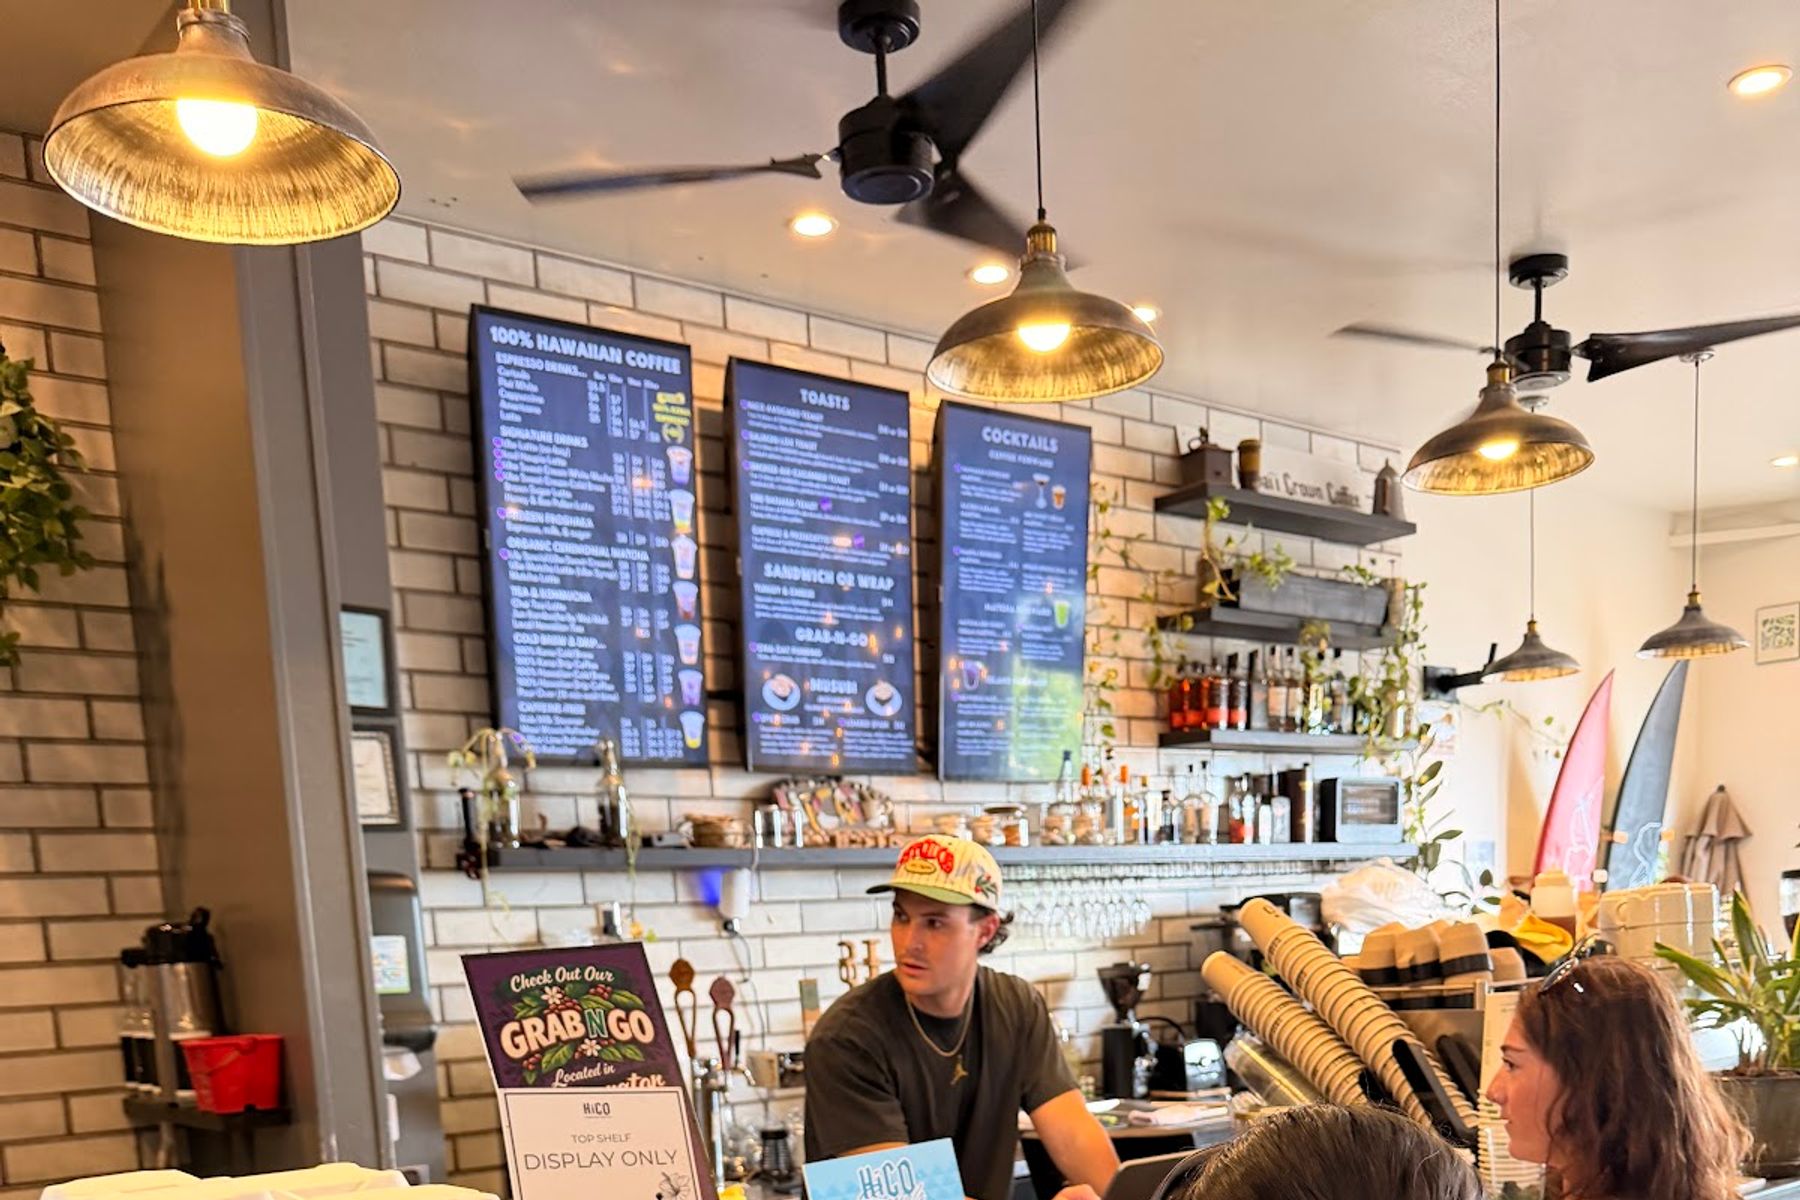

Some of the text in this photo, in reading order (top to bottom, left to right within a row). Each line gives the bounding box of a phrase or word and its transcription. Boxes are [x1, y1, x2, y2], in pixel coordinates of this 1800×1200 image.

[489, 326, 681, 374] 100% HAWAIIAN COFFEE
[800, 388, 850, 411] TOASTS
[982, 426, 1058, 454] COCKTAILS
[764, 562, 894, 592] SANDWICH OR WRAP
[510, 966, 614, 993] Check Out Our
[500, 1009, 655, 1059] GRAB N GO
[552, 1066, 602, 1088] Located
[600, 1064, 616, 1076] in
[571, 1133, 632, 1144] TOP SHELF
[524, 1150, 678, 1170] DISPLAY ONLY
[859, 1157, 916, 1200] HiCO
